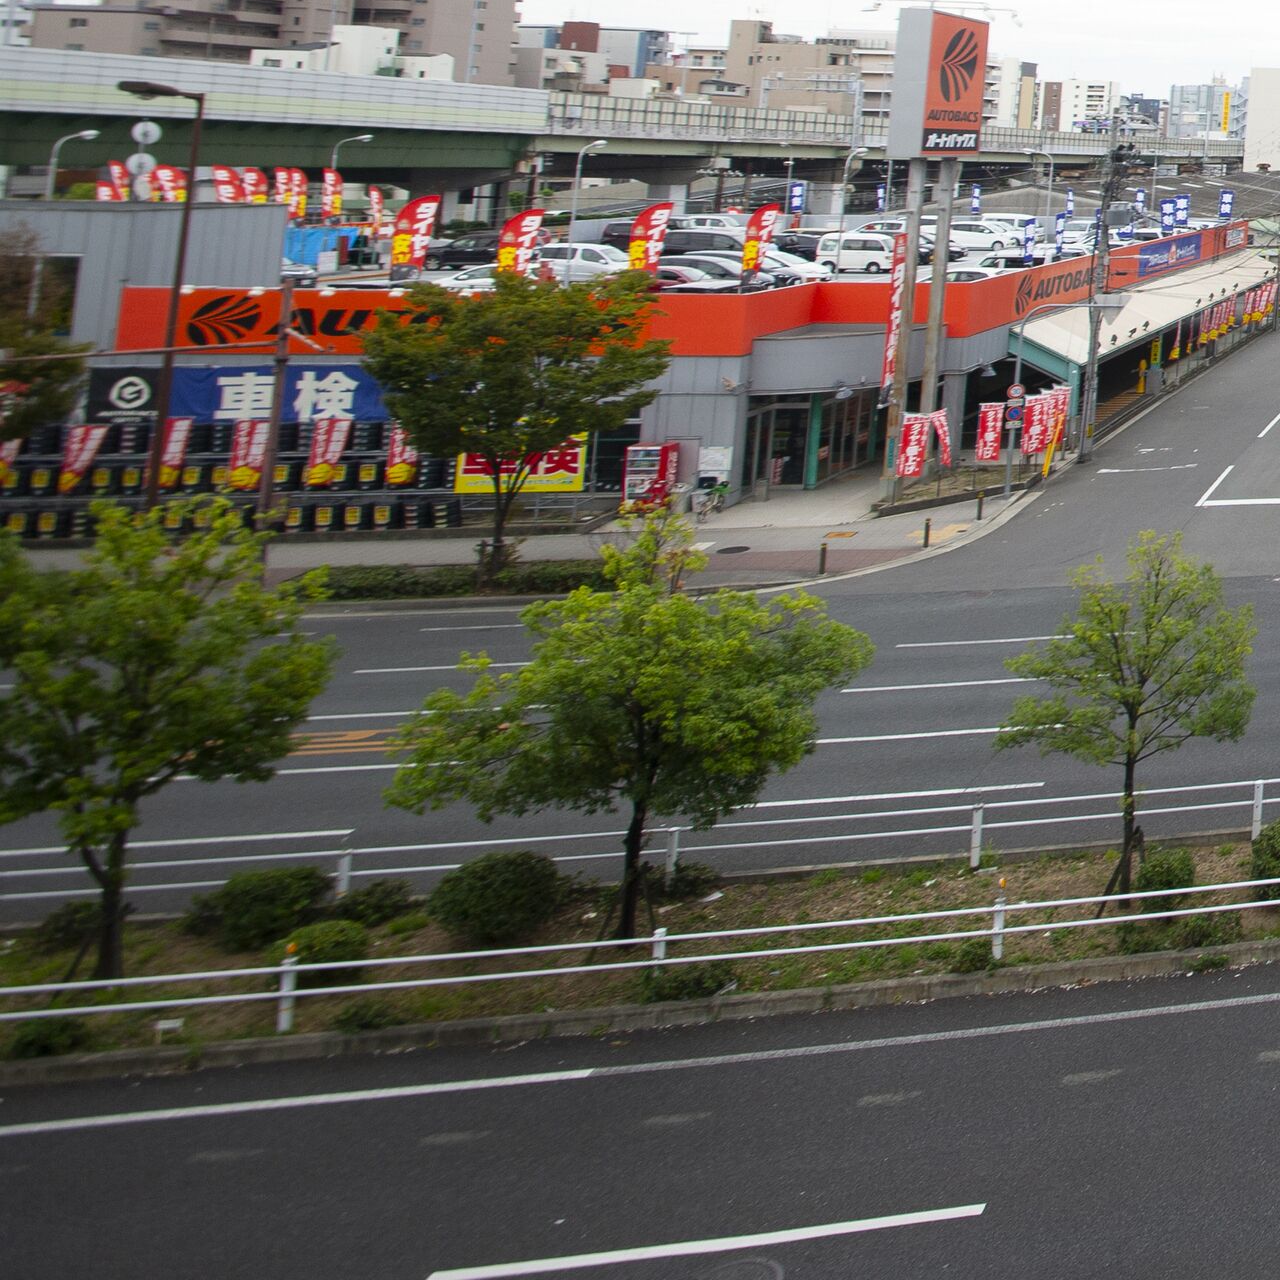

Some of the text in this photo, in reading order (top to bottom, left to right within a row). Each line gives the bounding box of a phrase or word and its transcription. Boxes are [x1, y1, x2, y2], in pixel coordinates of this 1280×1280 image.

[927, 109, 979, 123] AUTOBACS
[925, 132, 978, 148] オートバックス
[214, 371, 360, 421] 車検
